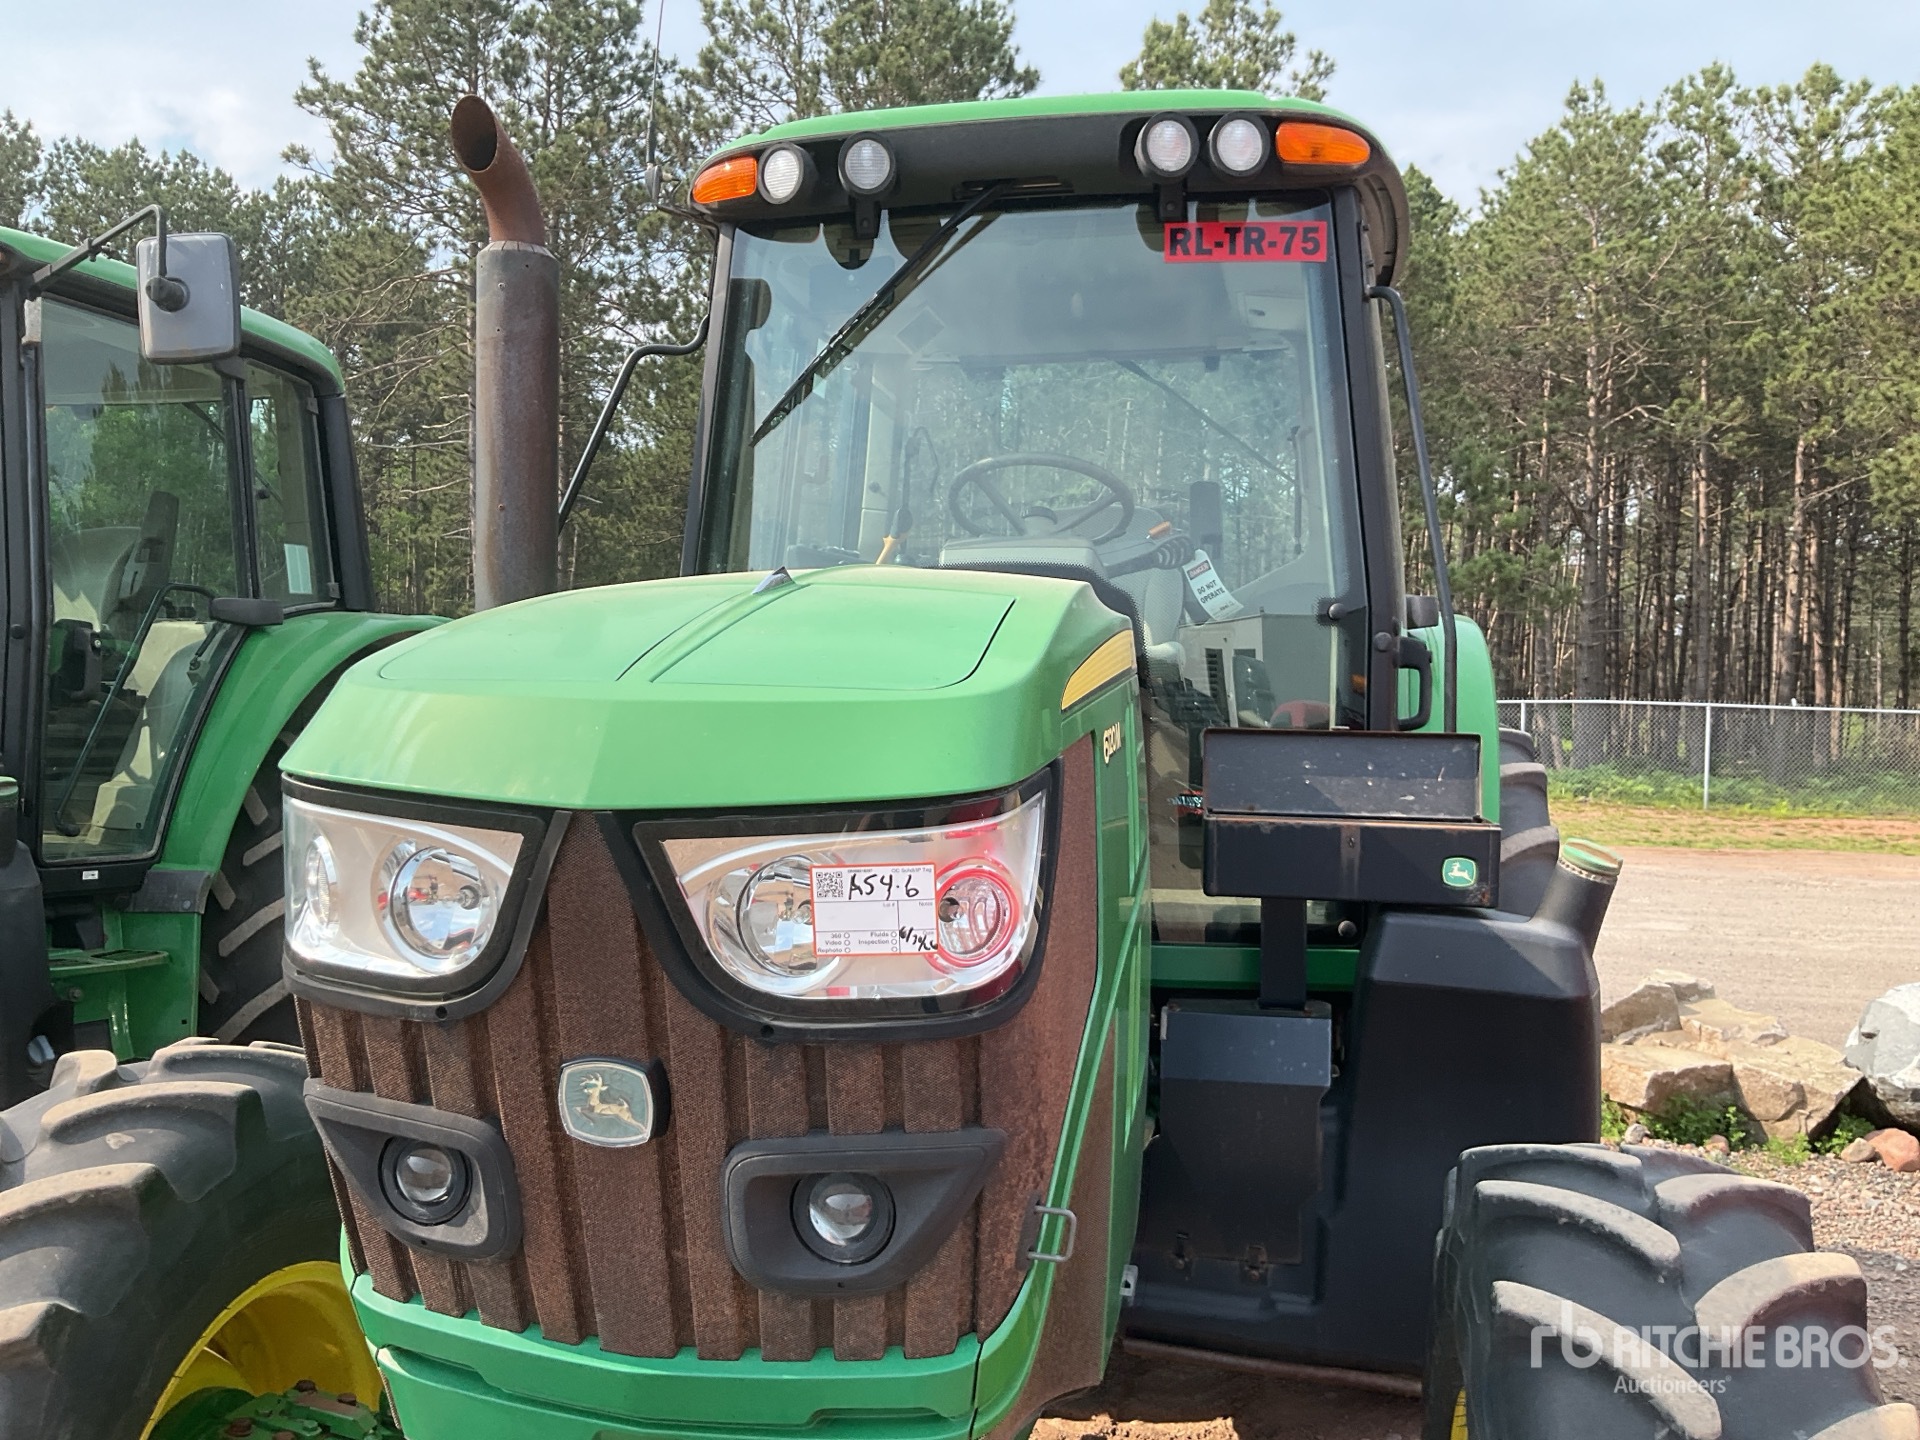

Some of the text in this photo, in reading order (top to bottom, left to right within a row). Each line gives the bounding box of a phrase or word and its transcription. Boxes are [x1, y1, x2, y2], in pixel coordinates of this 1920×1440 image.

[1169, 226, 1321, 256] RL-TR-75
[1197, 579, 1217, 595] DO NOT
[1200, 587, 1226, 604] OPERATE
